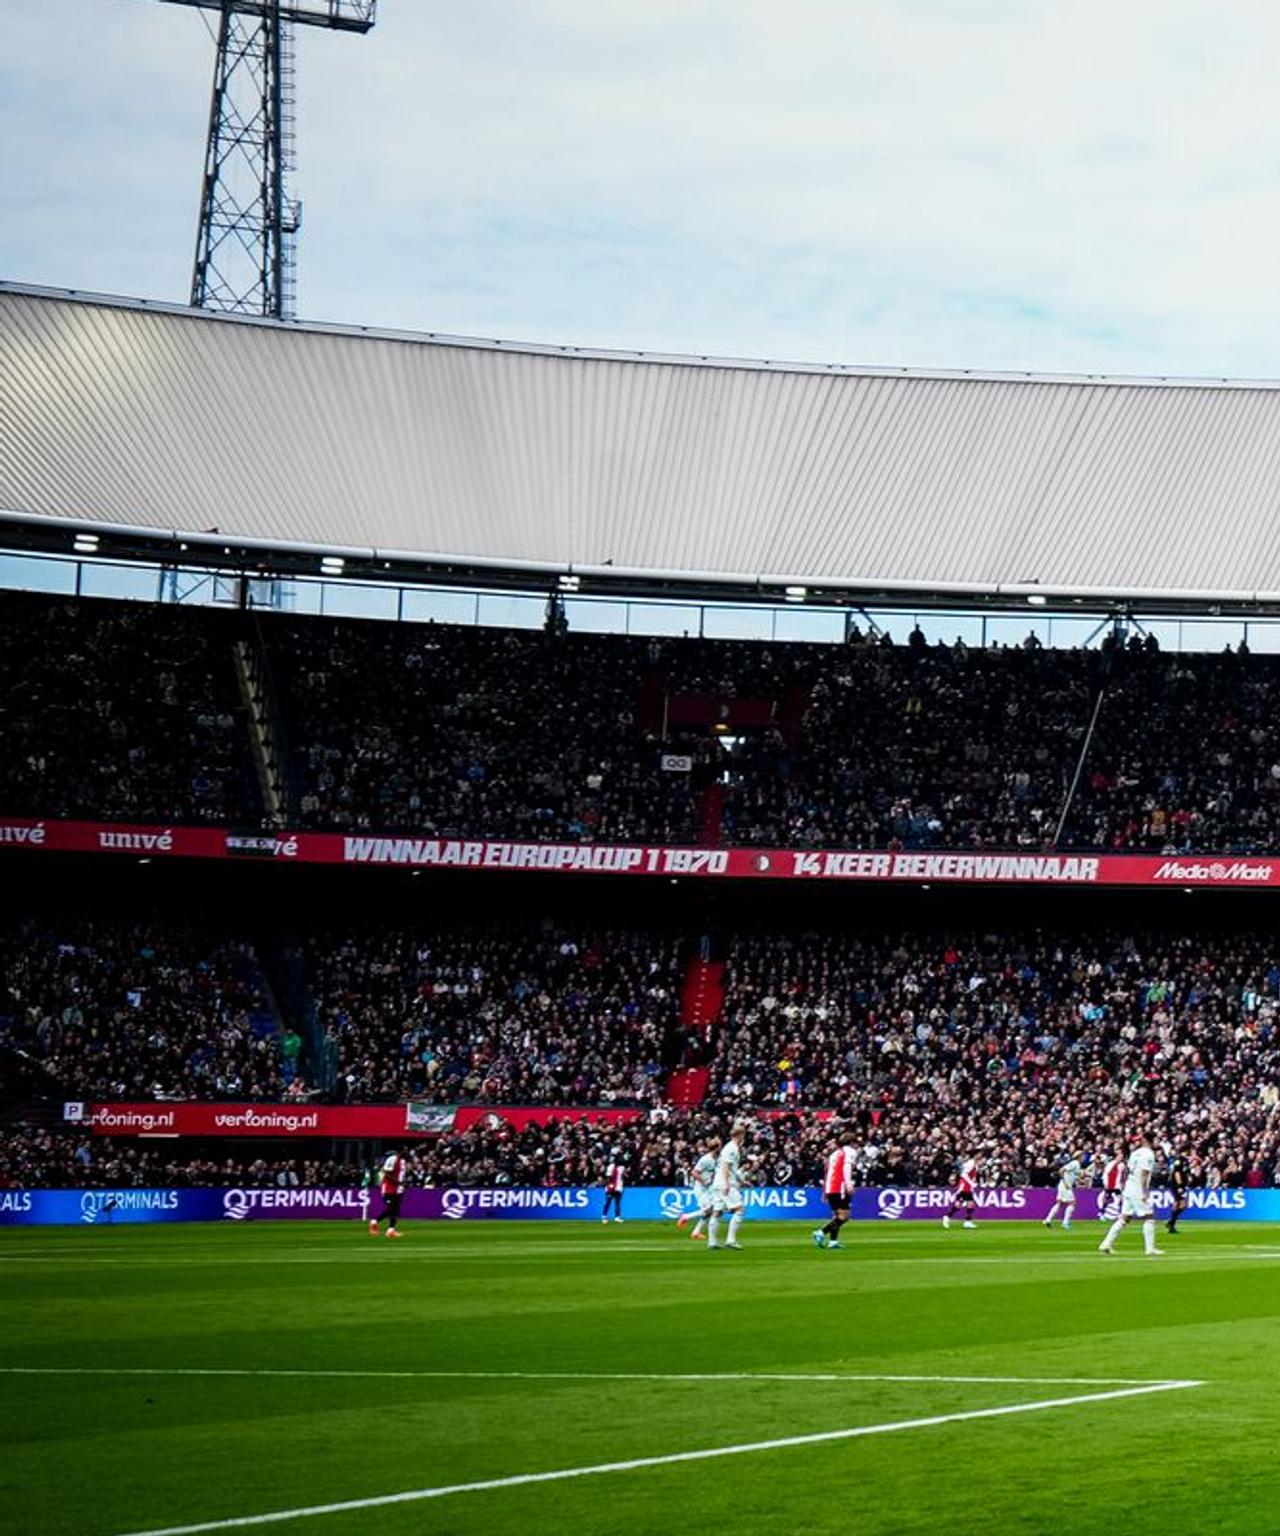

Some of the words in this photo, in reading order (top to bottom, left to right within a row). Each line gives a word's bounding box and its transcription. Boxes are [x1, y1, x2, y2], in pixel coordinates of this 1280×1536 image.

[667, 758, 688, 768] QQ
[0, 822, 46, 844] ivé
[99, 829, 173, 851] univé
[344, 838, 481, 866] WINNAAR
[482, 842, 643, 871] EUROPACUP
[647, 848, 660, 872] 1
[663, 849, 729, 874] 1970
[793, 853, 821, 876] 14
[823, 854, 890, 877] KEER
[891, 855, 1099, 881] BEKERWINNAAR
[68, 1105, 77, 1117] P
[73, 1109, 174, 1130] erloning.nl
[0, 1191, 32, 1212] ALS
[223, 1189, 370, 1219] QTERMINALS
[441, 1188, 589, 1219] QTERMINALS
[660, 1189, 807, 1218] QTINALS
[878, 1189, 1026, 1219] QTERMNALS
[1097, 1189, 1246, 1220] QRMNALS
